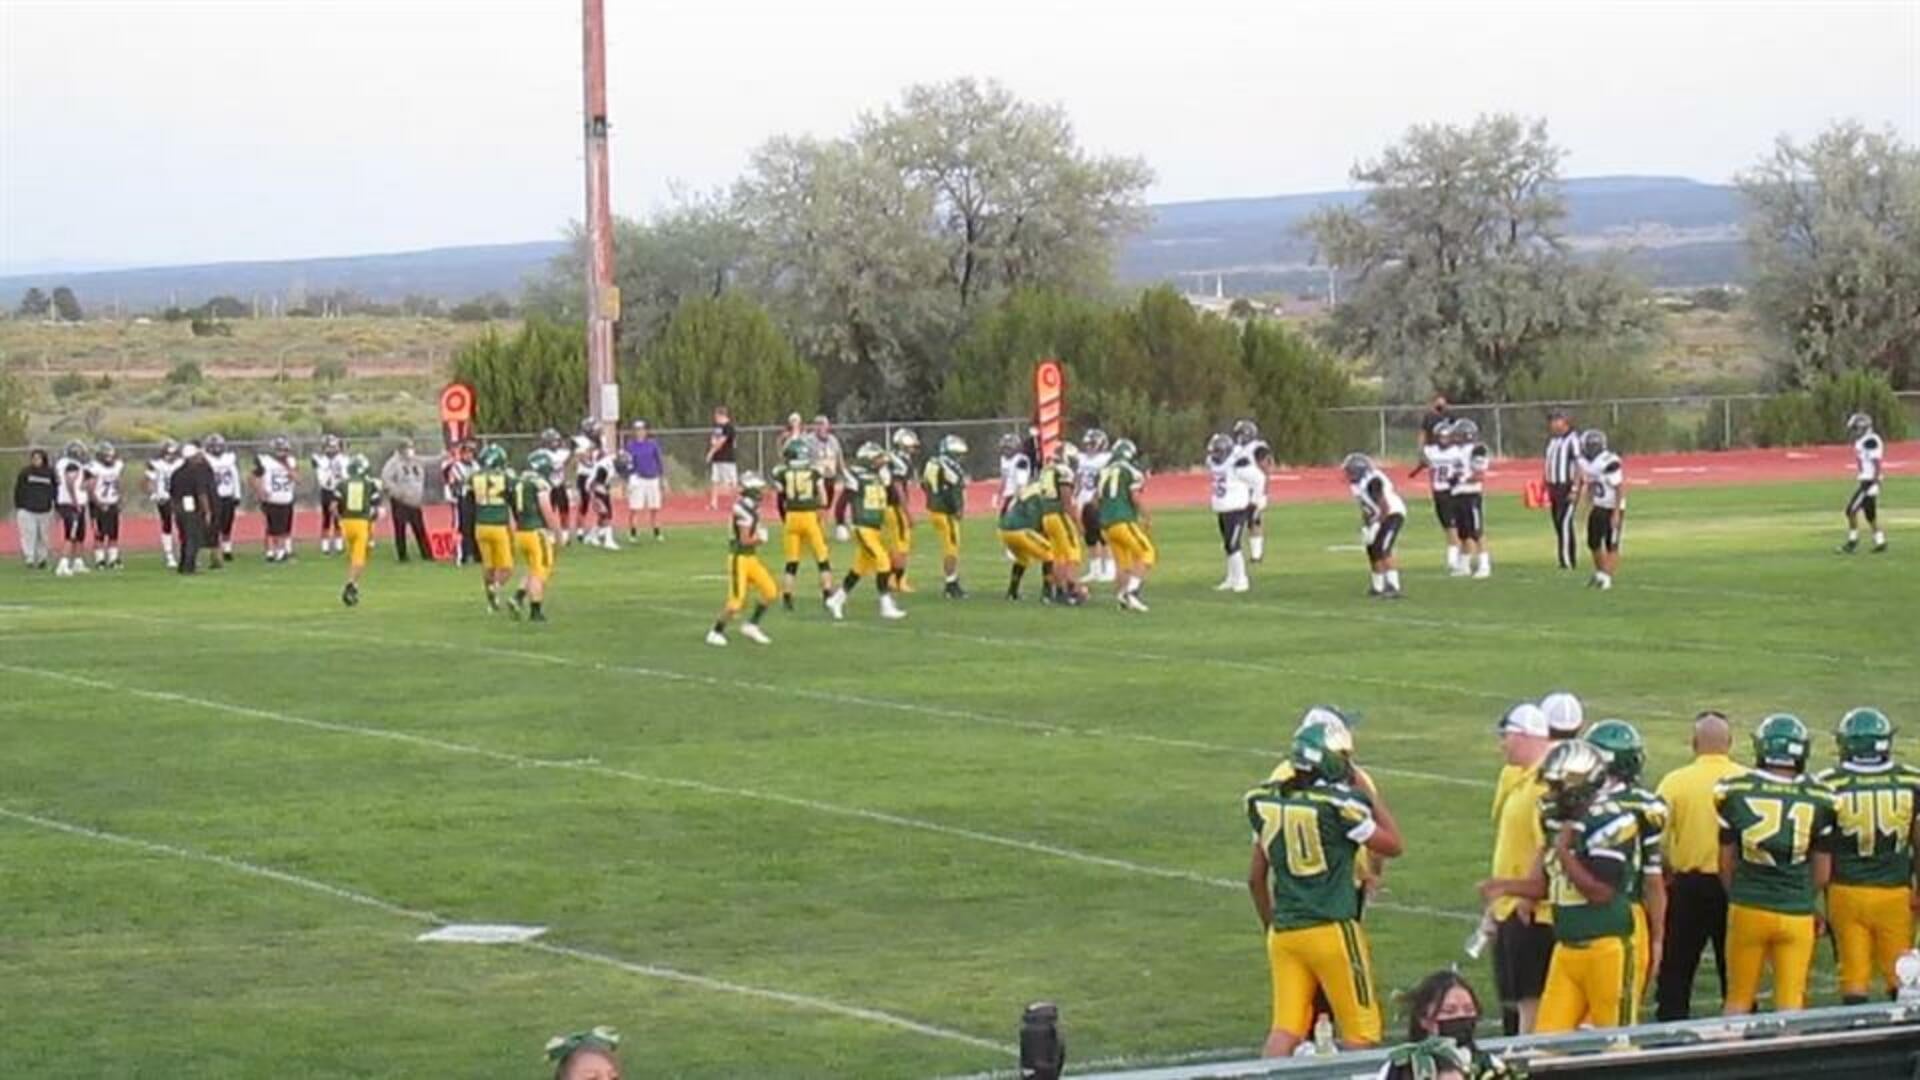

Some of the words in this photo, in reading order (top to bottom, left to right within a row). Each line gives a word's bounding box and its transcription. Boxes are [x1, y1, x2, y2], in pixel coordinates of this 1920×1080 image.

[1255, 801, 1328, 876] 70
[1742, 798, 1815, 866] 21
[1837, 789, 1914, 857] 44
